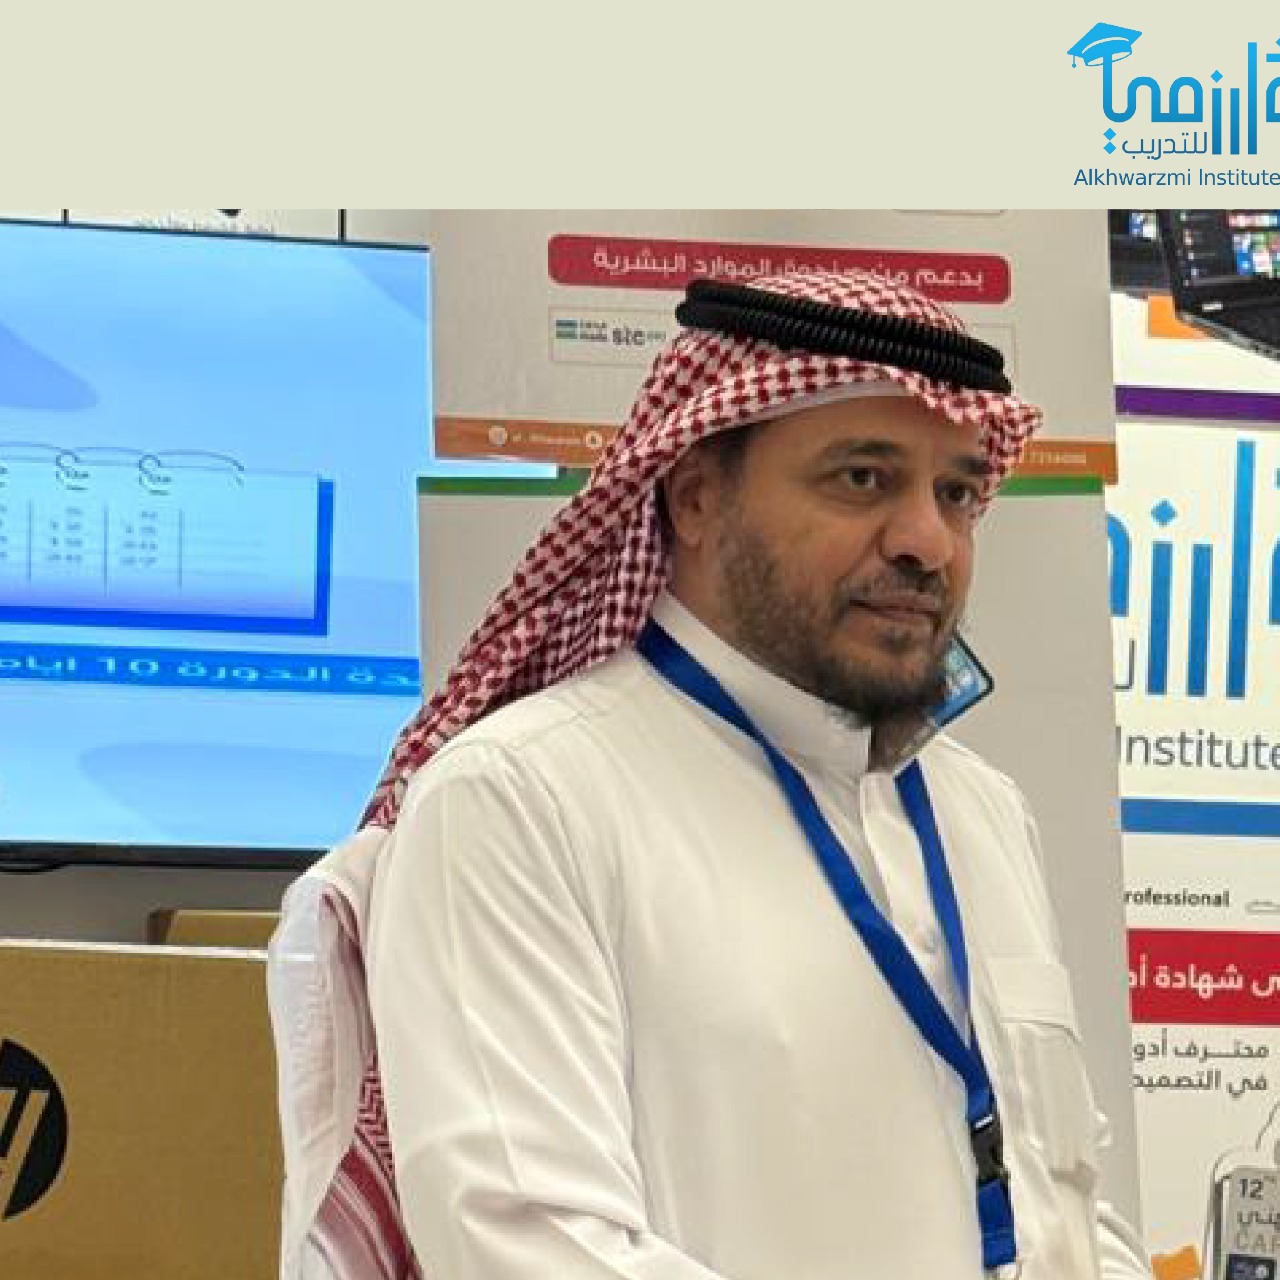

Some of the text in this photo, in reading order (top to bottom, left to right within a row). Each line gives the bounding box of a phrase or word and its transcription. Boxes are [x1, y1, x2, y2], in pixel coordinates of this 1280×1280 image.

[593, 246, 687, 278] البشرية
[96, 656, 160, 677] 10
[1154, 962, 1243, 1000] شهادة
